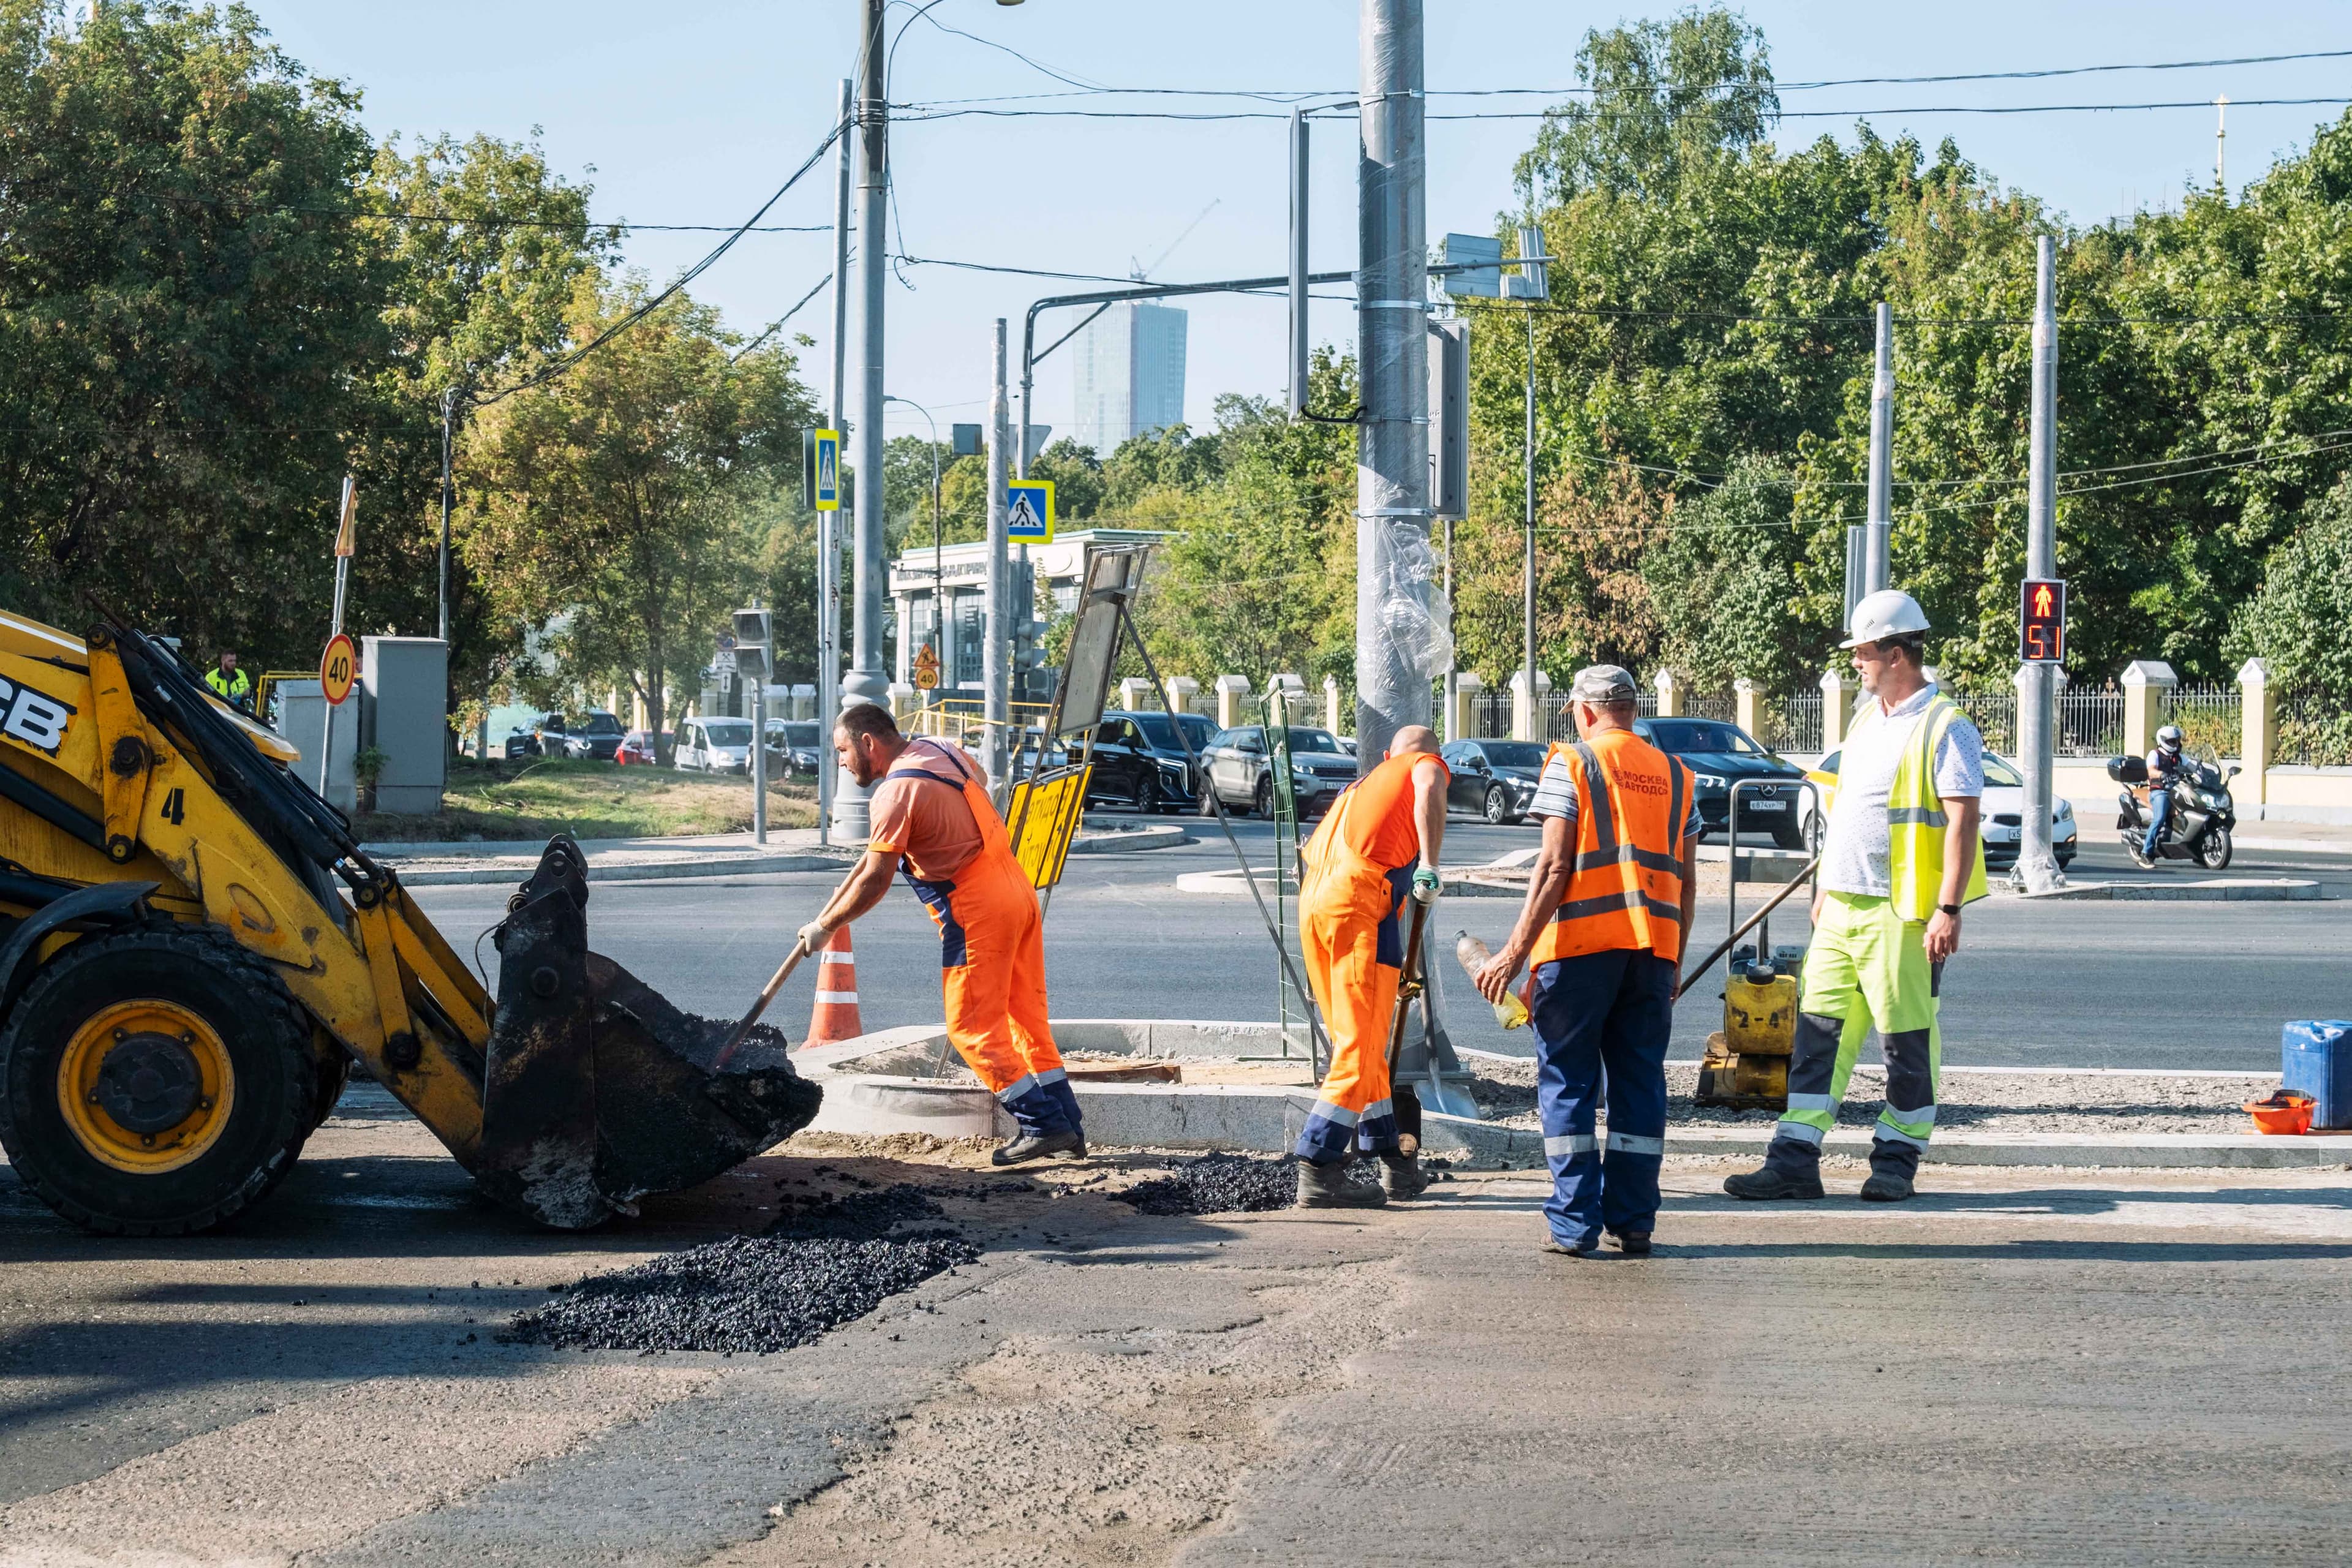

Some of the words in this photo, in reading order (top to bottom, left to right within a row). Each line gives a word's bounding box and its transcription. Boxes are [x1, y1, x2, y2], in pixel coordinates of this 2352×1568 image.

[2028, 624, 2060, 659] 51
[329, 657, 349, 683] 40
[921, 674, 933, 684] 40
[0, 678, 67, 749] B
[1624, 771, 1668, 788] МОСКВА
[160, 788, 186, 825] 4
